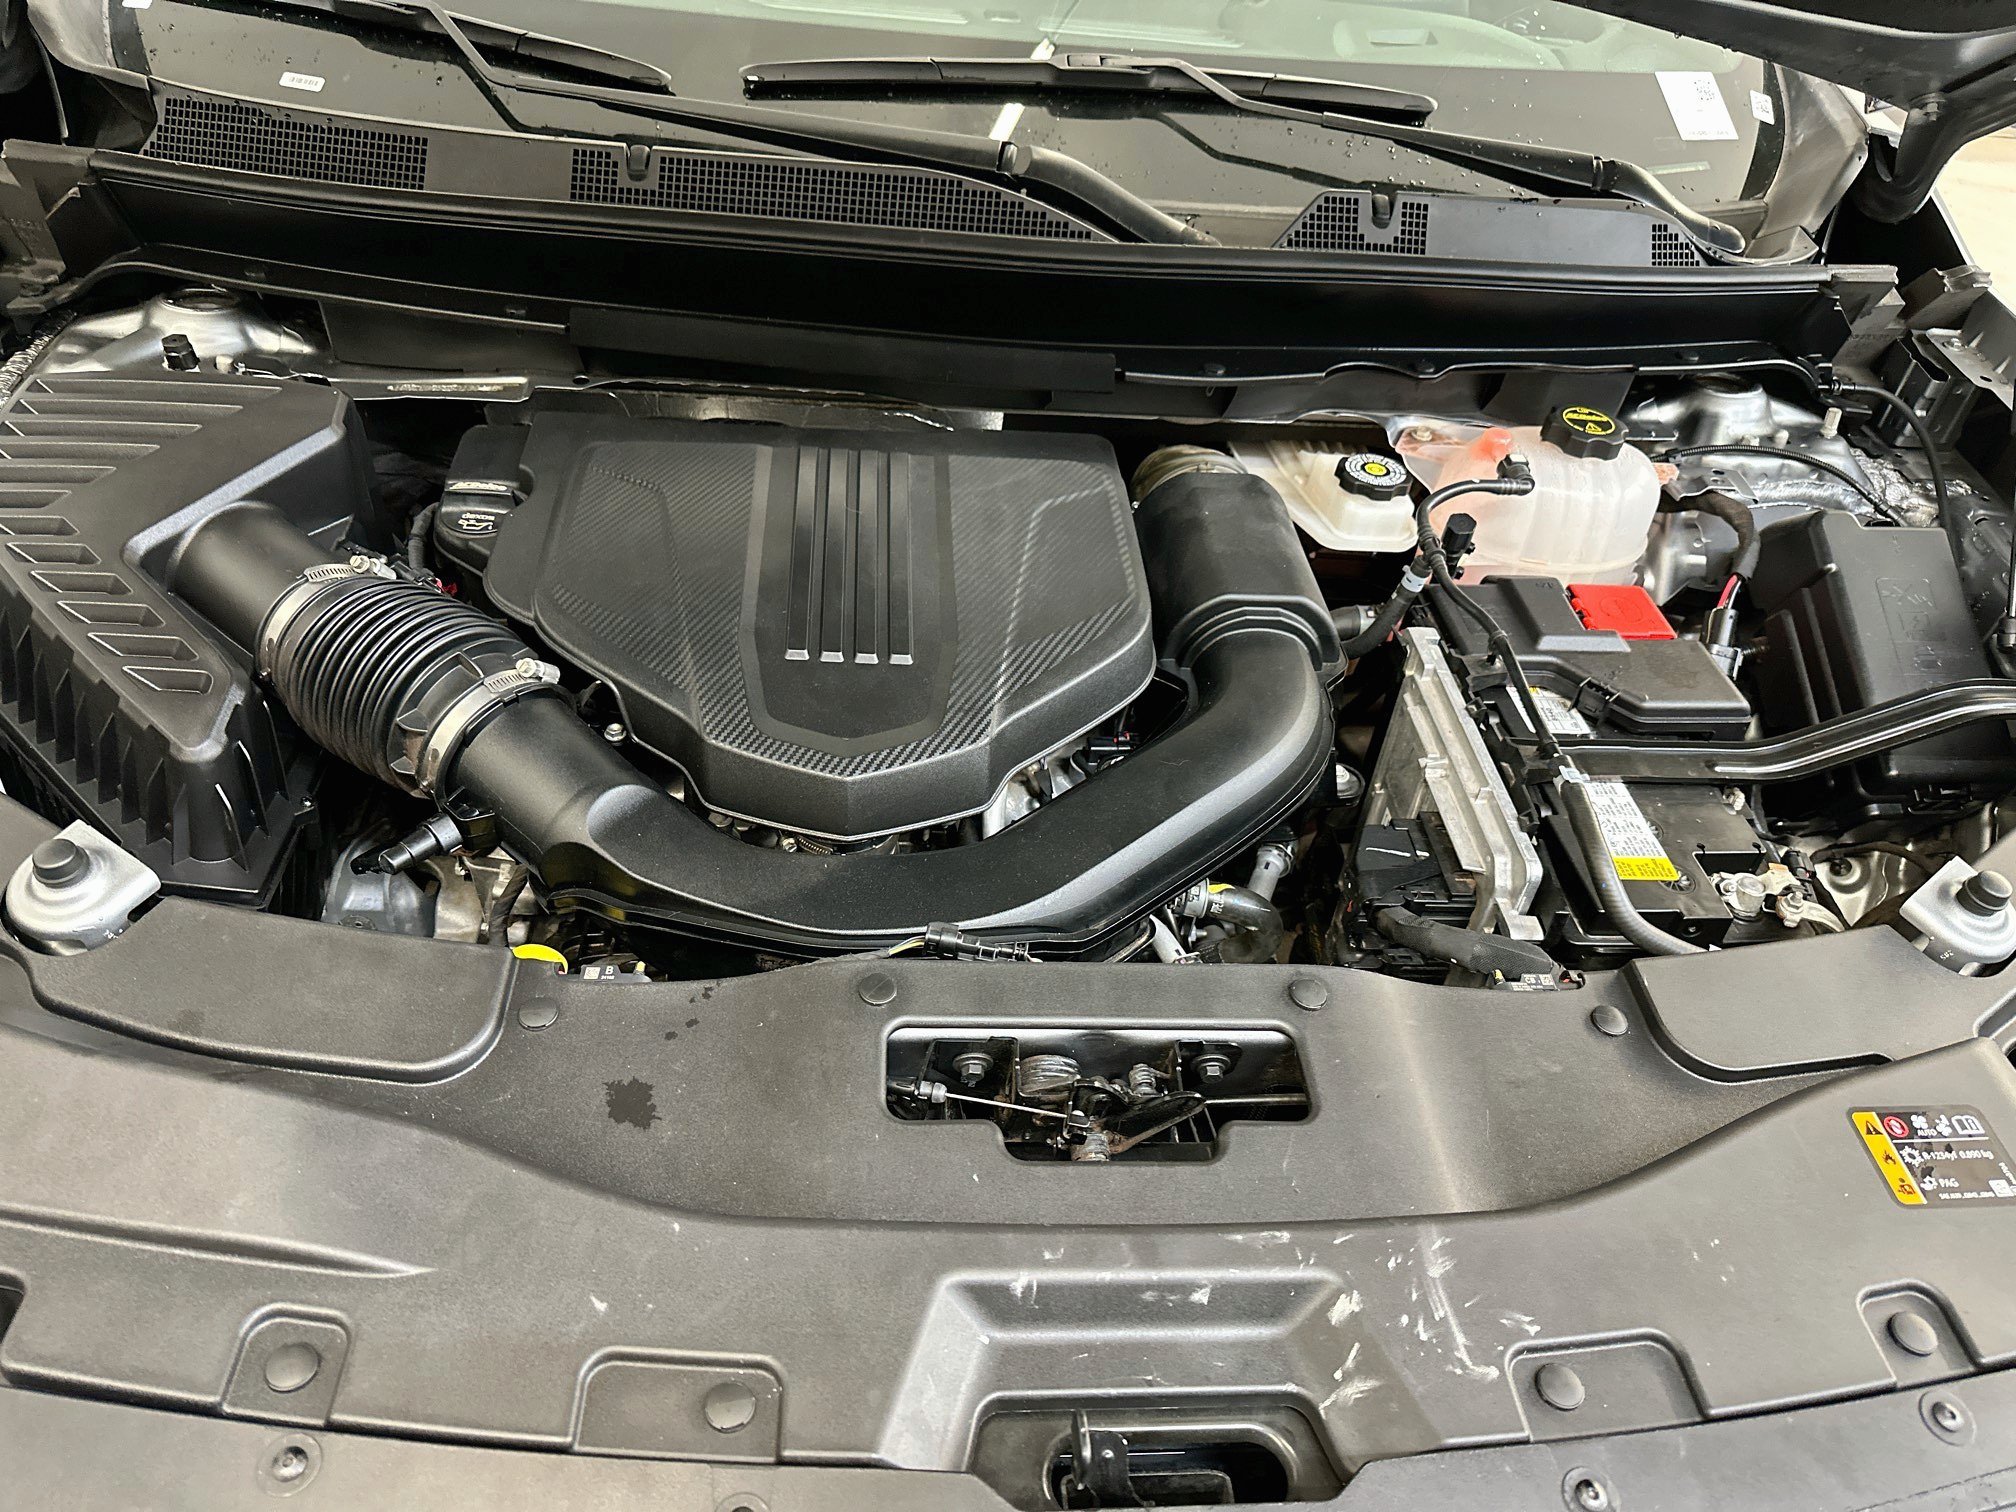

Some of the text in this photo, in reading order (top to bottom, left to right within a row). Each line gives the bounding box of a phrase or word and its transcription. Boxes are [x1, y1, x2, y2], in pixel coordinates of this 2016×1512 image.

[605, 966, 614, 974] B
[1917, 1128, 1937, 1136] AUTO
[1981, 1150, 1994, 1159] kg
[1938, 1178, 1959, 1187] PAG
